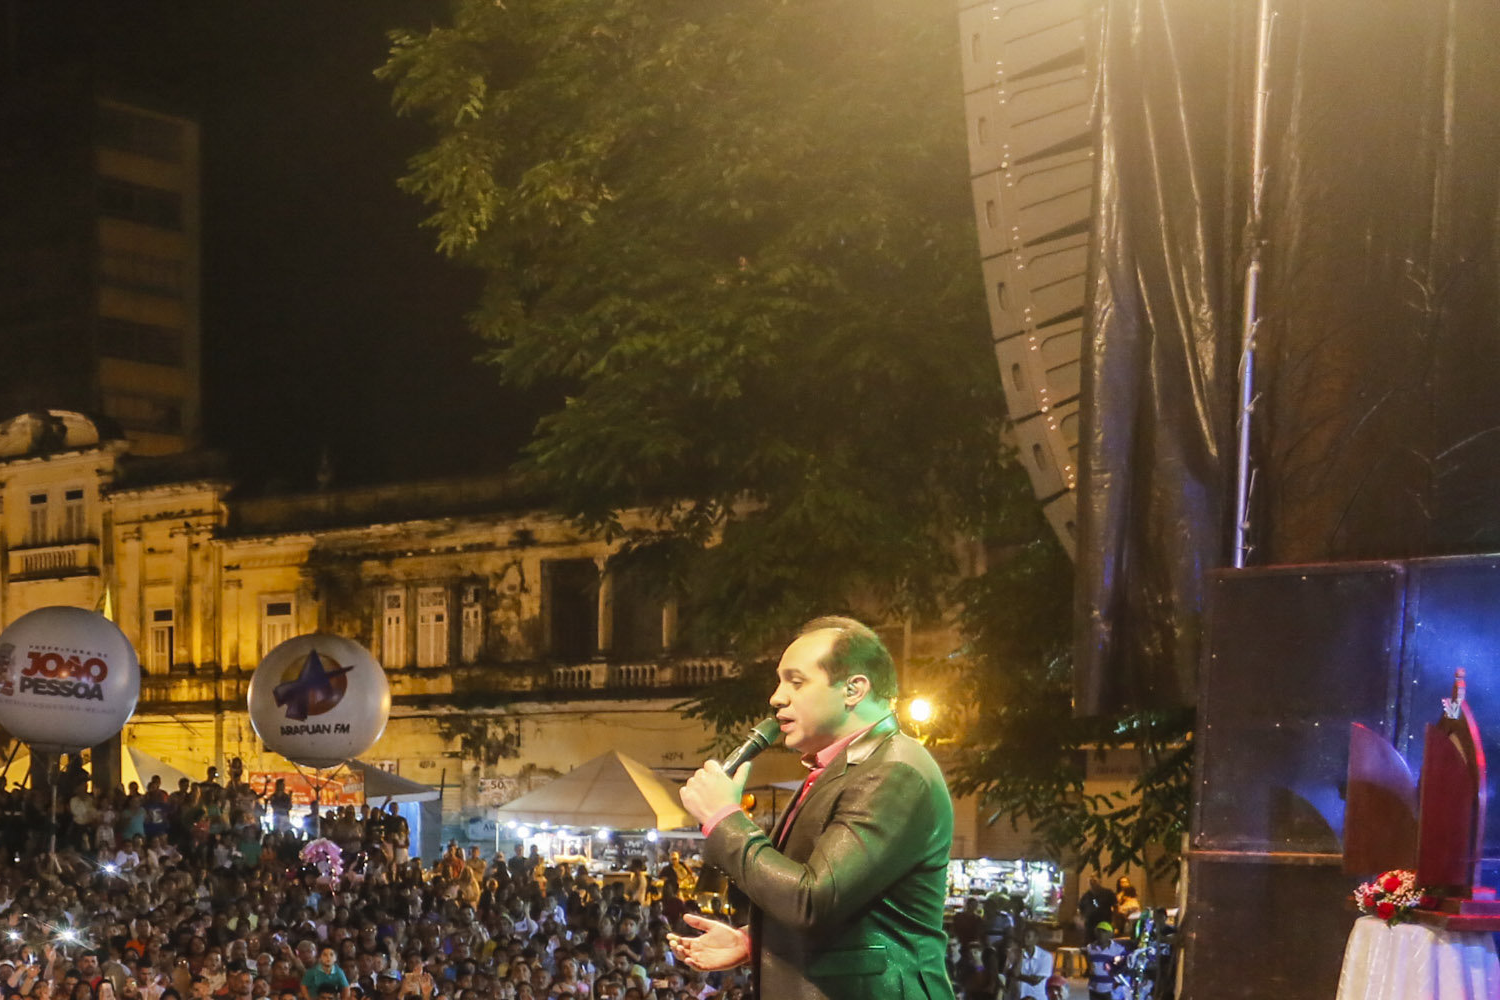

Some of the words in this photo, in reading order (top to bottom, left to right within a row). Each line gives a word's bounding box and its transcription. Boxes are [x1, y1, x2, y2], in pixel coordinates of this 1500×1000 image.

[21, 651, 108, 683] JOÃO
[20, 676, 104, 701] PESSOA
[280, 724, 331, 736] ARAPUAN
[333, 723, 351, 734] FM
